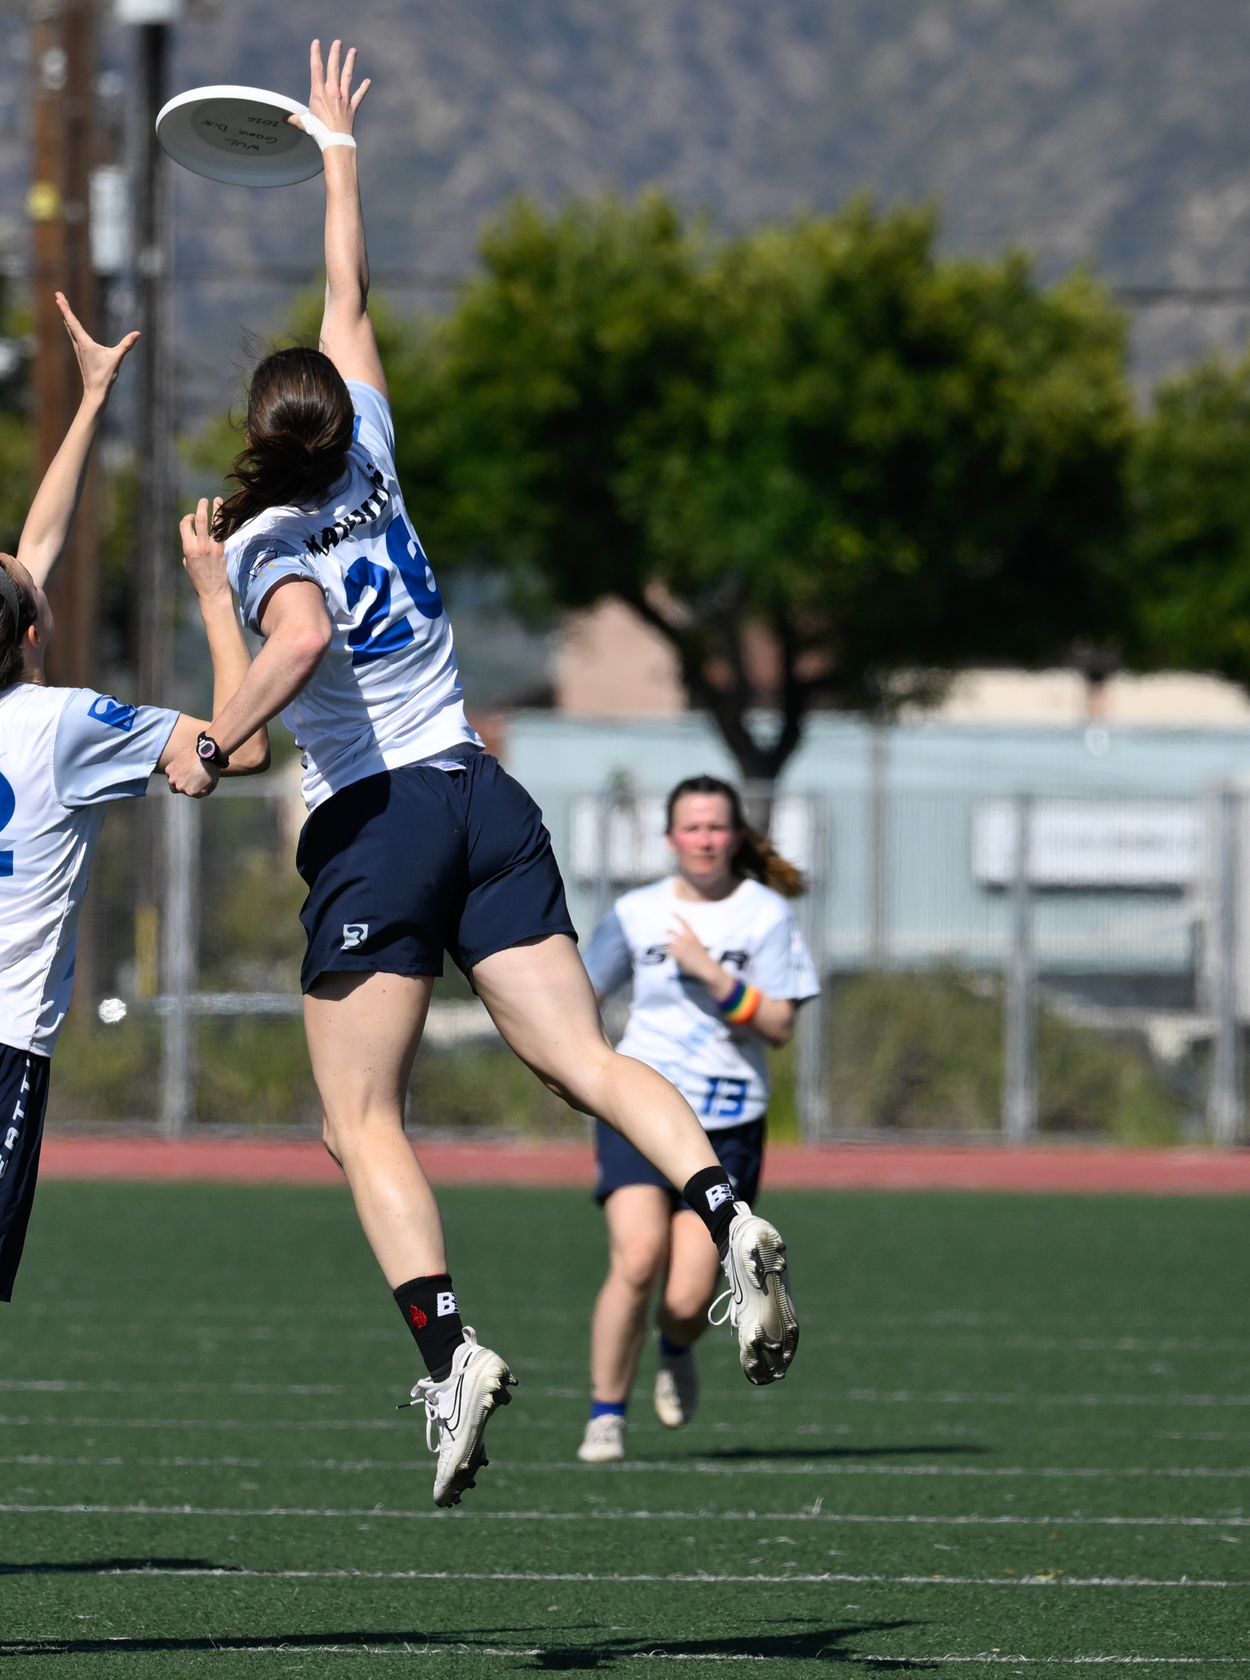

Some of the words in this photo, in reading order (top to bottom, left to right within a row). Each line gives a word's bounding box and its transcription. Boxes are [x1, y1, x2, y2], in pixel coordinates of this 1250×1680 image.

[248, 116, 279, 128] 2026
[238, 129, 278, 144] Game
[225, 138, 260, 151] WUL
